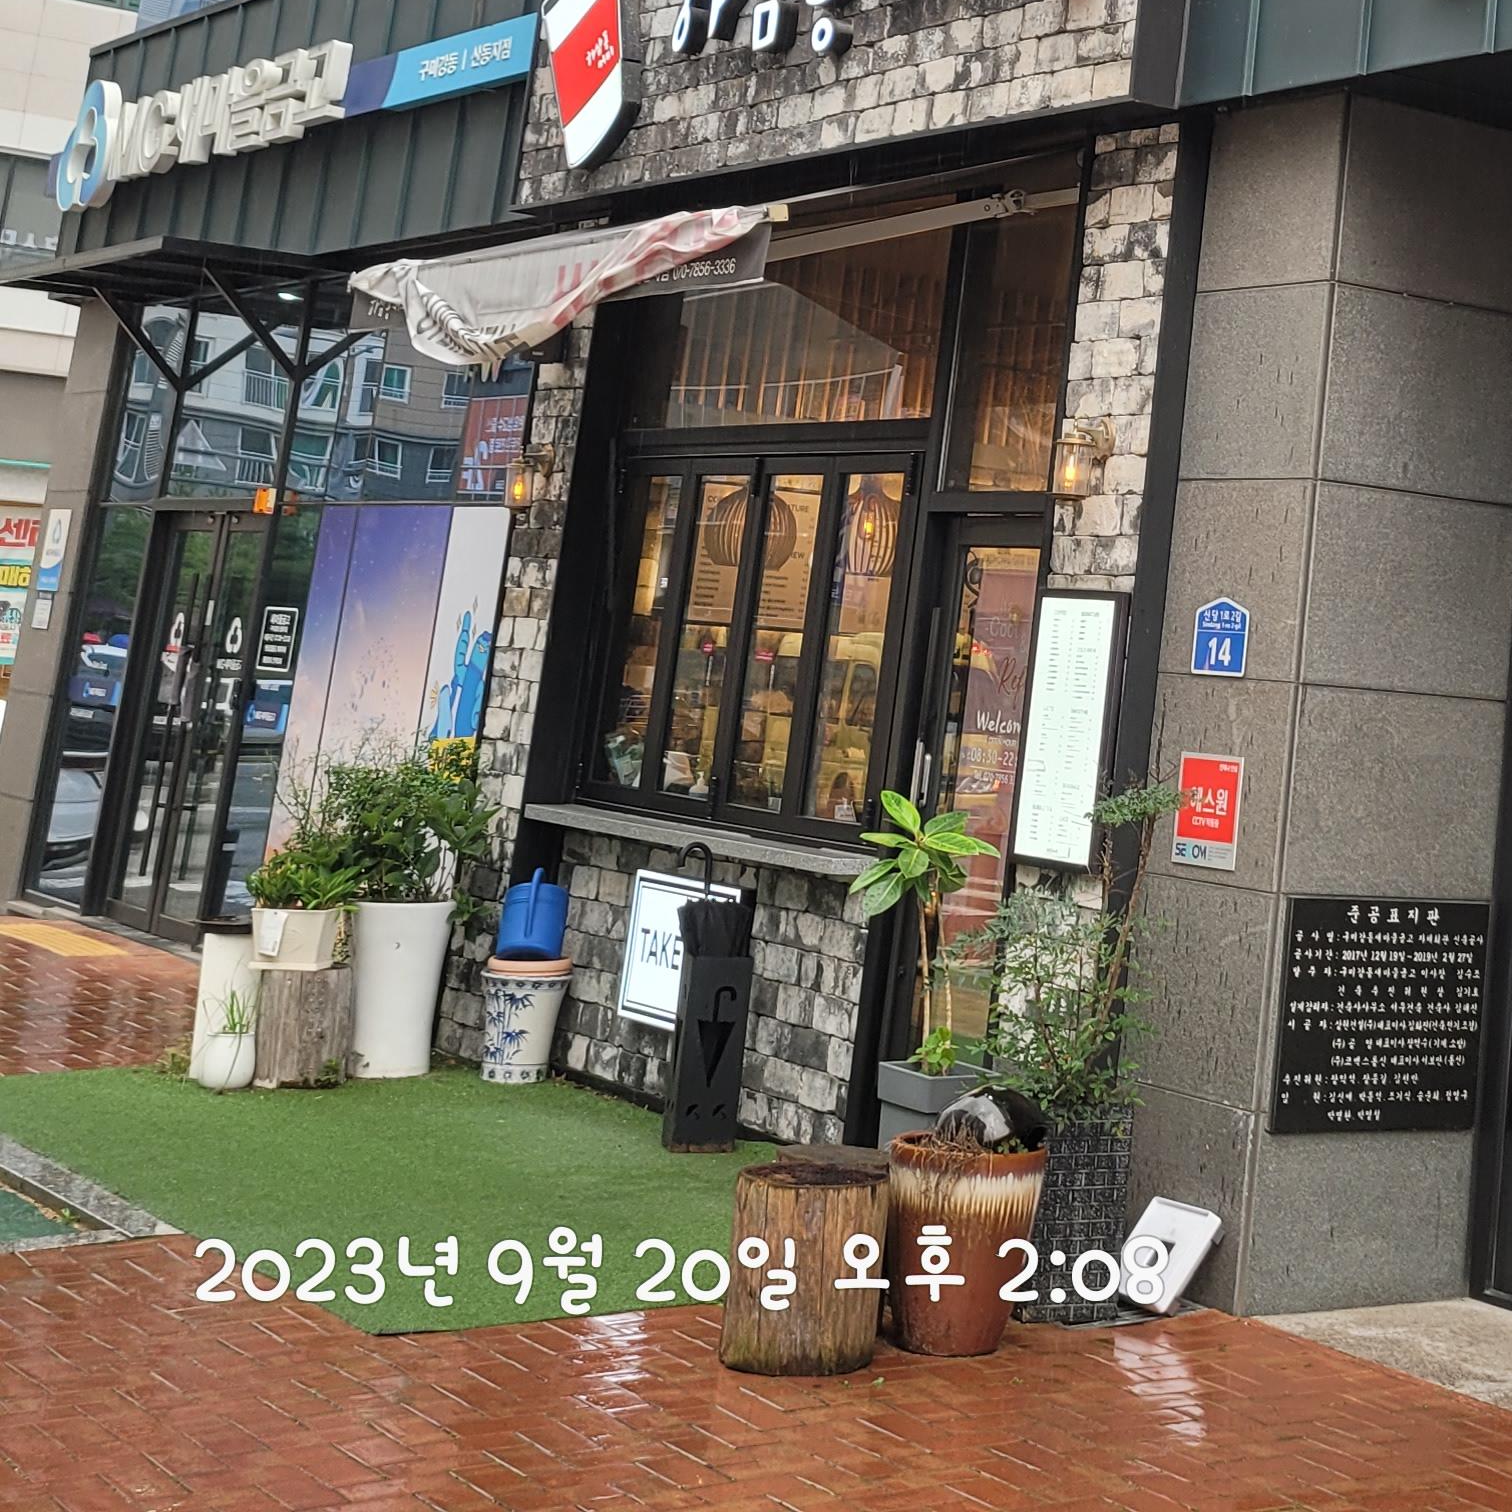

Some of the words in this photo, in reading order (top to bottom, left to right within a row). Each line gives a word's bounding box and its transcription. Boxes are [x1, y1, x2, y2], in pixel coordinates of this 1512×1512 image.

[107, 39, 353, 182] MG새마을금고
[1208, 636, 1232, 667] 14
[641, 926, 681, 972] TAKE
